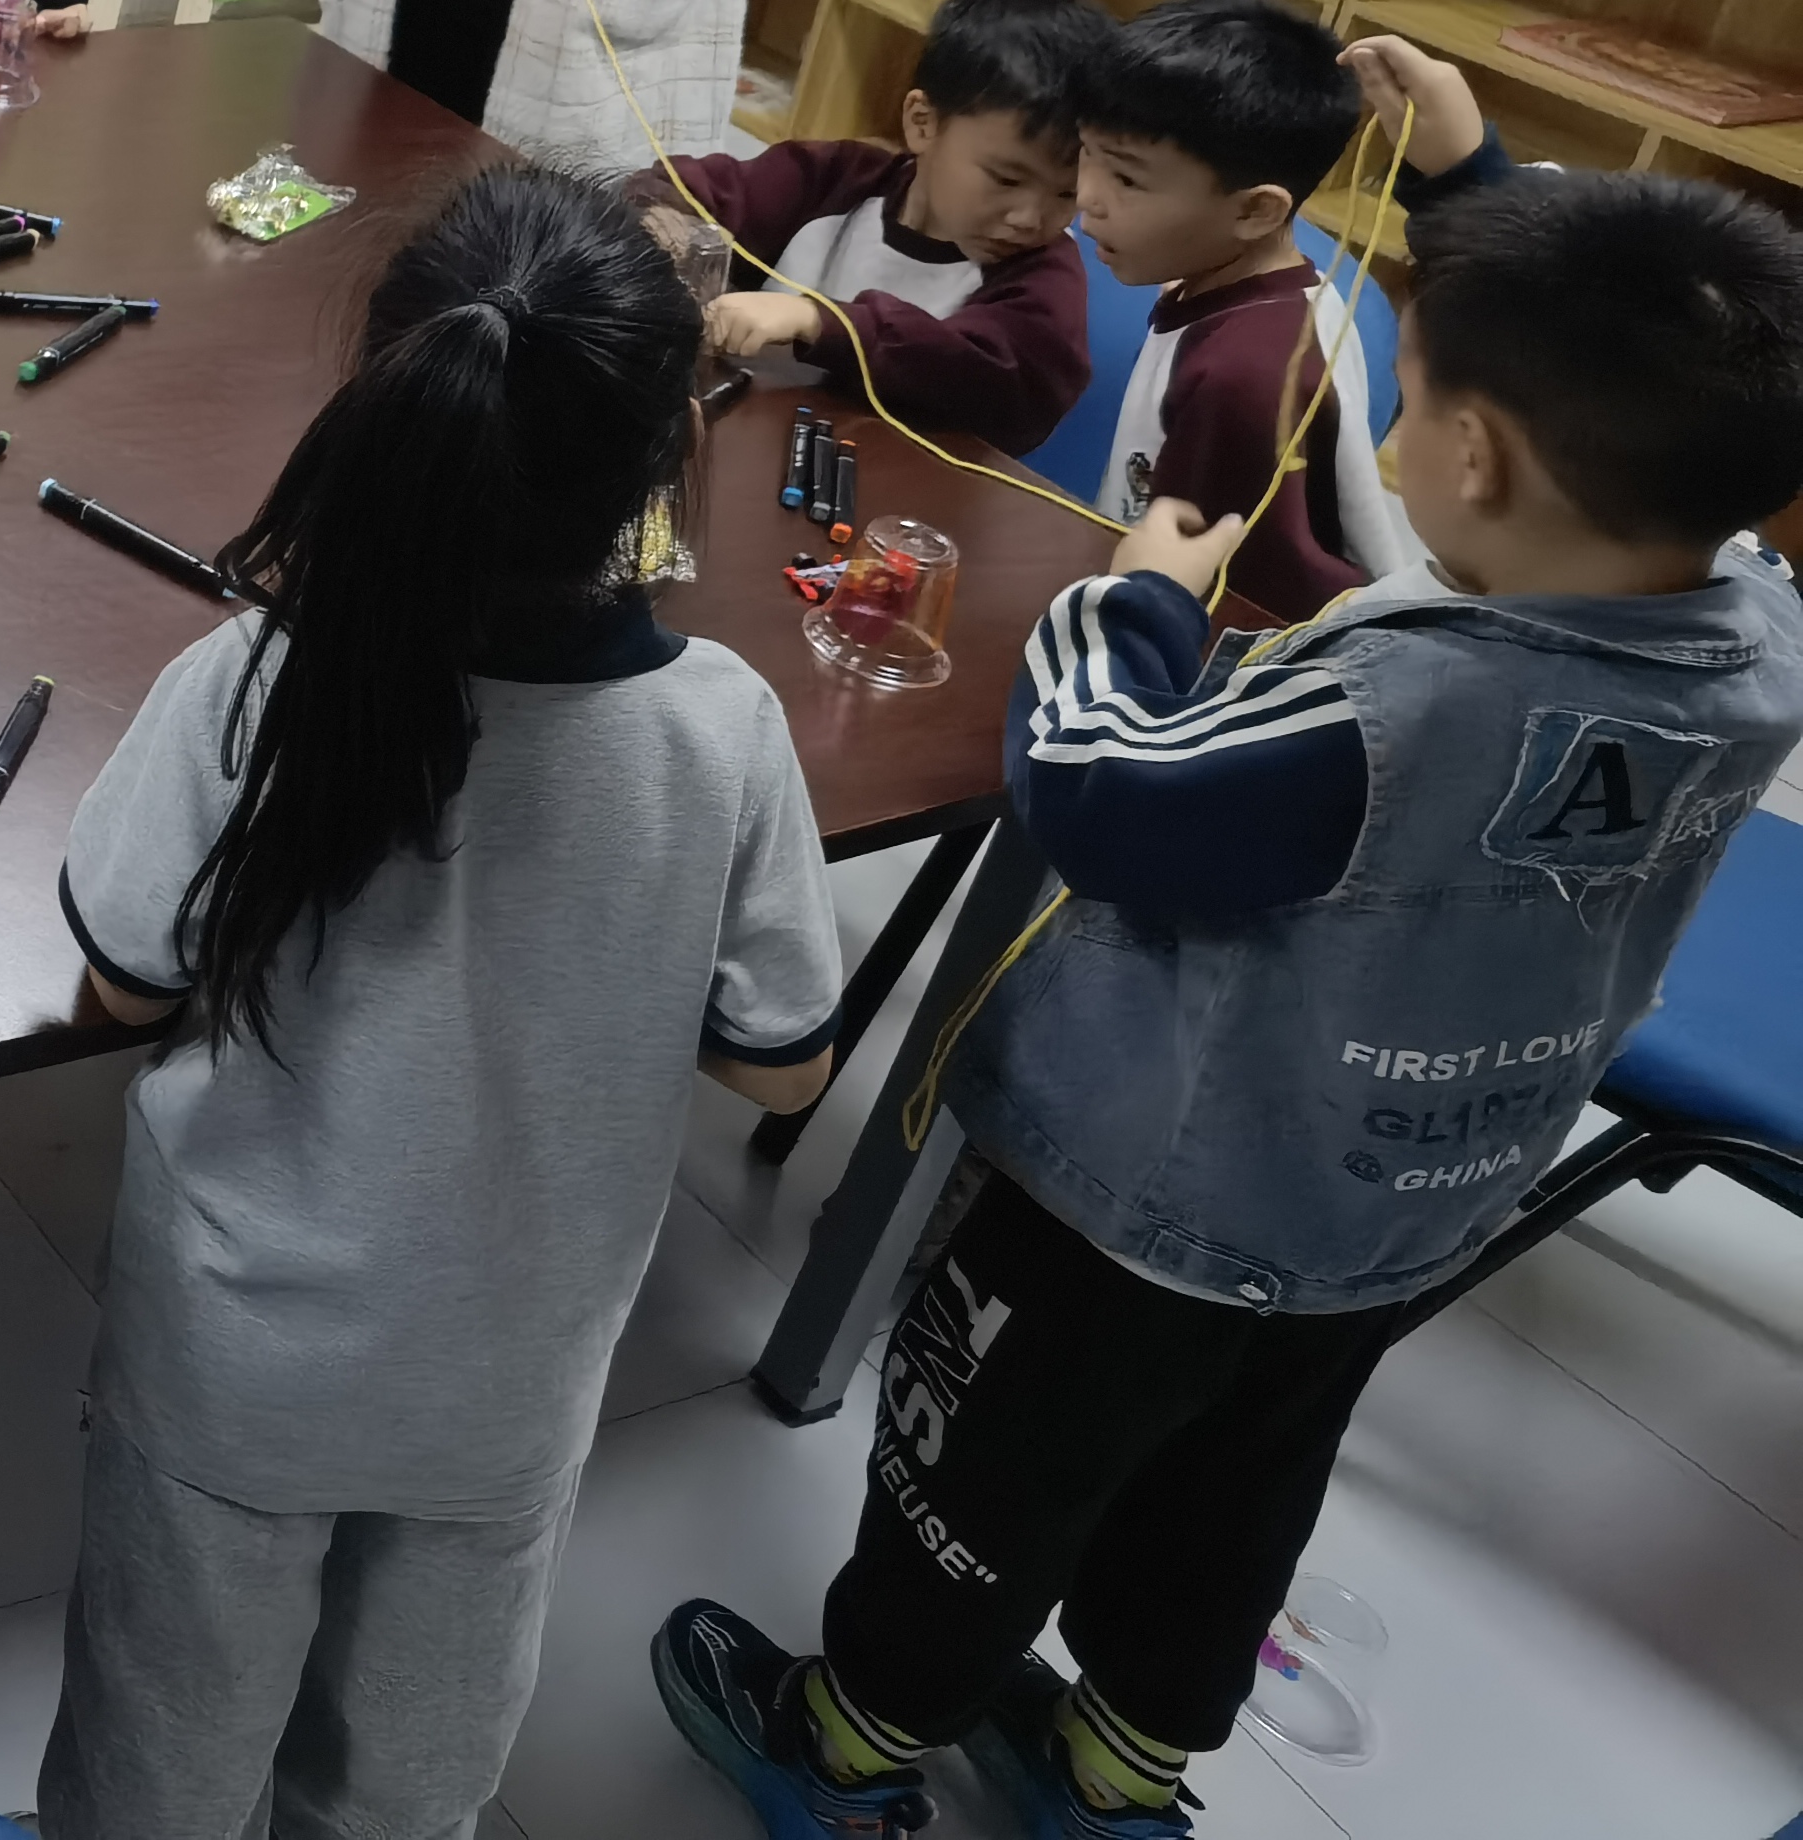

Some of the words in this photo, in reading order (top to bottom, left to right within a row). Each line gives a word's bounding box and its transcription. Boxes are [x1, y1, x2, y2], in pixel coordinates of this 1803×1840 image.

[1524, 739, 1649, 841] A
[1340, 1039, 1487, 1083] FIRST
[1494, 1017, 1607, 1070] LOVE
[1394, 1144, 1523, 1193] GHINA
